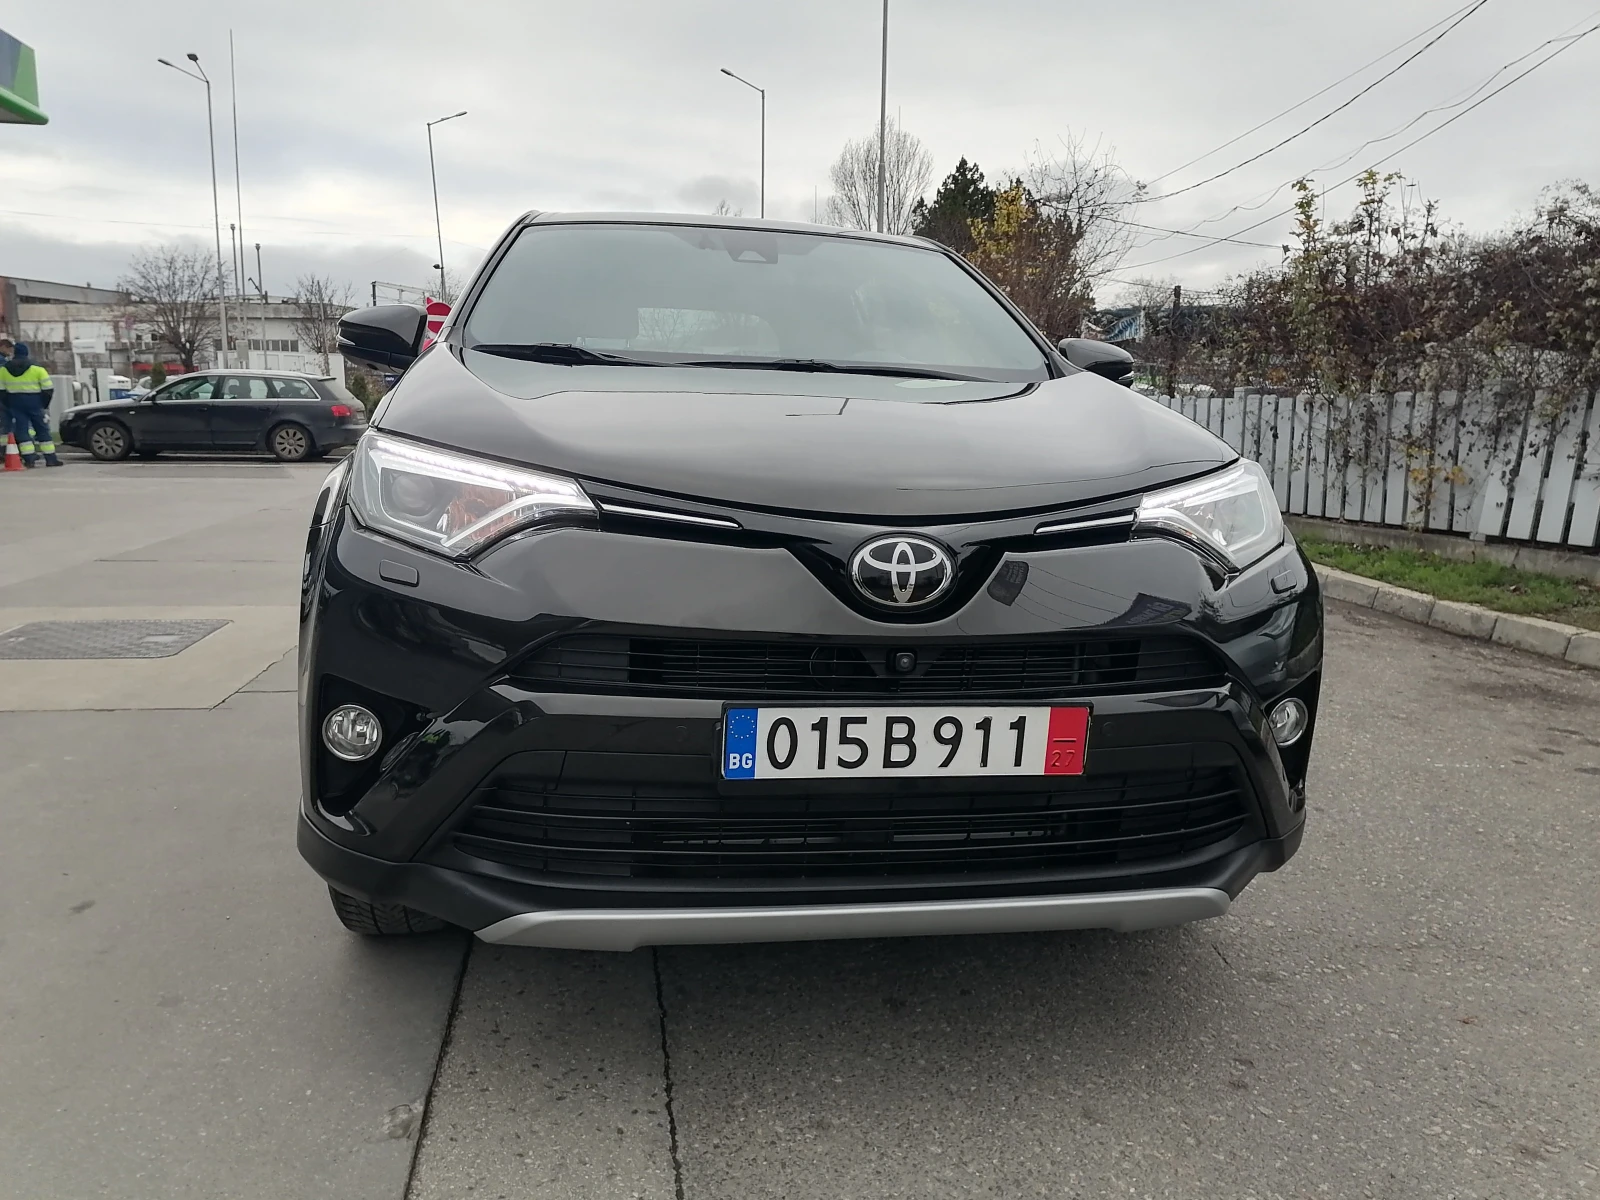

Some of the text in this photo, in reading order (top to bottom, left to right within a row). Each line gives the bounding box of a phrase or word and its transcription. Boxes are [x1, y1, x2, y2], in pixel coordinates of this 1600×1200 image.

[766, 715, 1027, 770] 015B911
[728, 752, 753, 770] BG
[1050, 749, 1076, 768] 27
